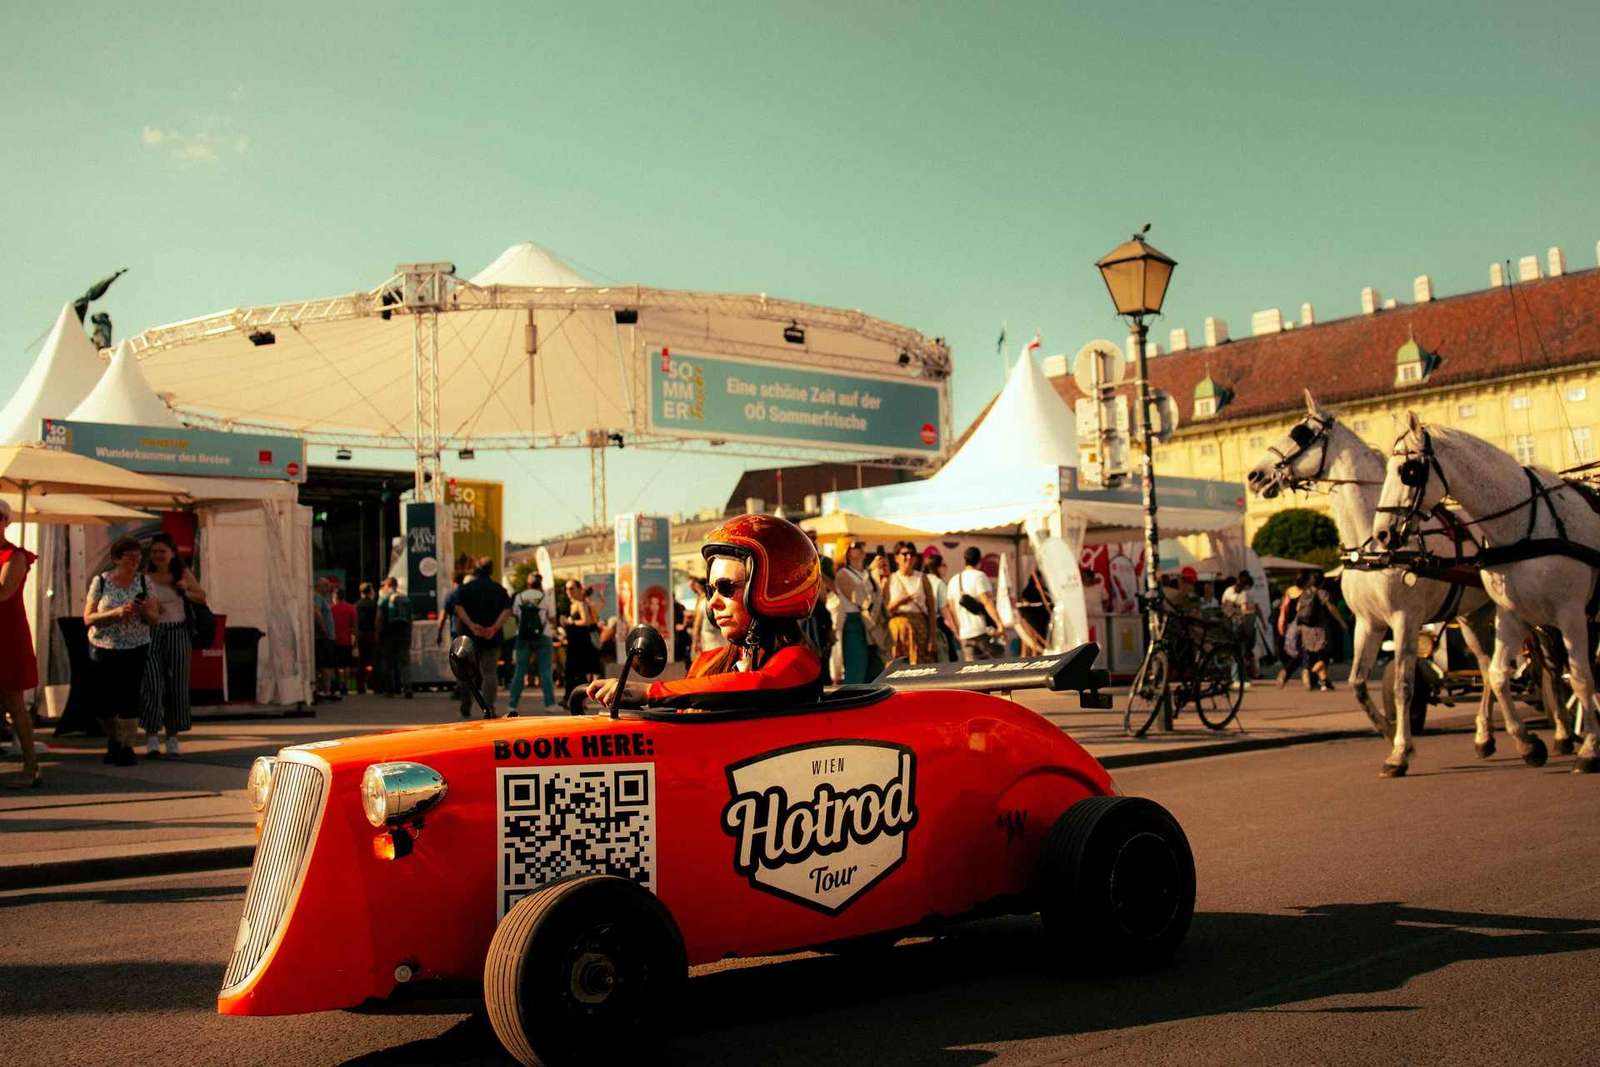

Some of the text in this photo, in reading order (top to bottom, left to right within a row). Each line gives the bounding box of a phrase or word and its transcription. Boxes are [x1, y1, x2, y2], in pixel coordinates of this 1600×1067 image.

[668, 361, 693, 380] SO
[663, 381, 694, 400] MM
[727, 377, 881, 409] Eine schöne Zeit auf der
[664, 400, 688, 419] ER
[744, 401, 867, 431] OÖ Sommerfrische
[95, 445, 177, 464] Wunderkammer
[454, 487, 475, 502] SO
[494, 733, 655, 760] BOOK HERE:
[812, 757, 845, 775] WIEN
[726, 753, 913, 867] Hotrod
[809, 865, 857, 894] Tour
